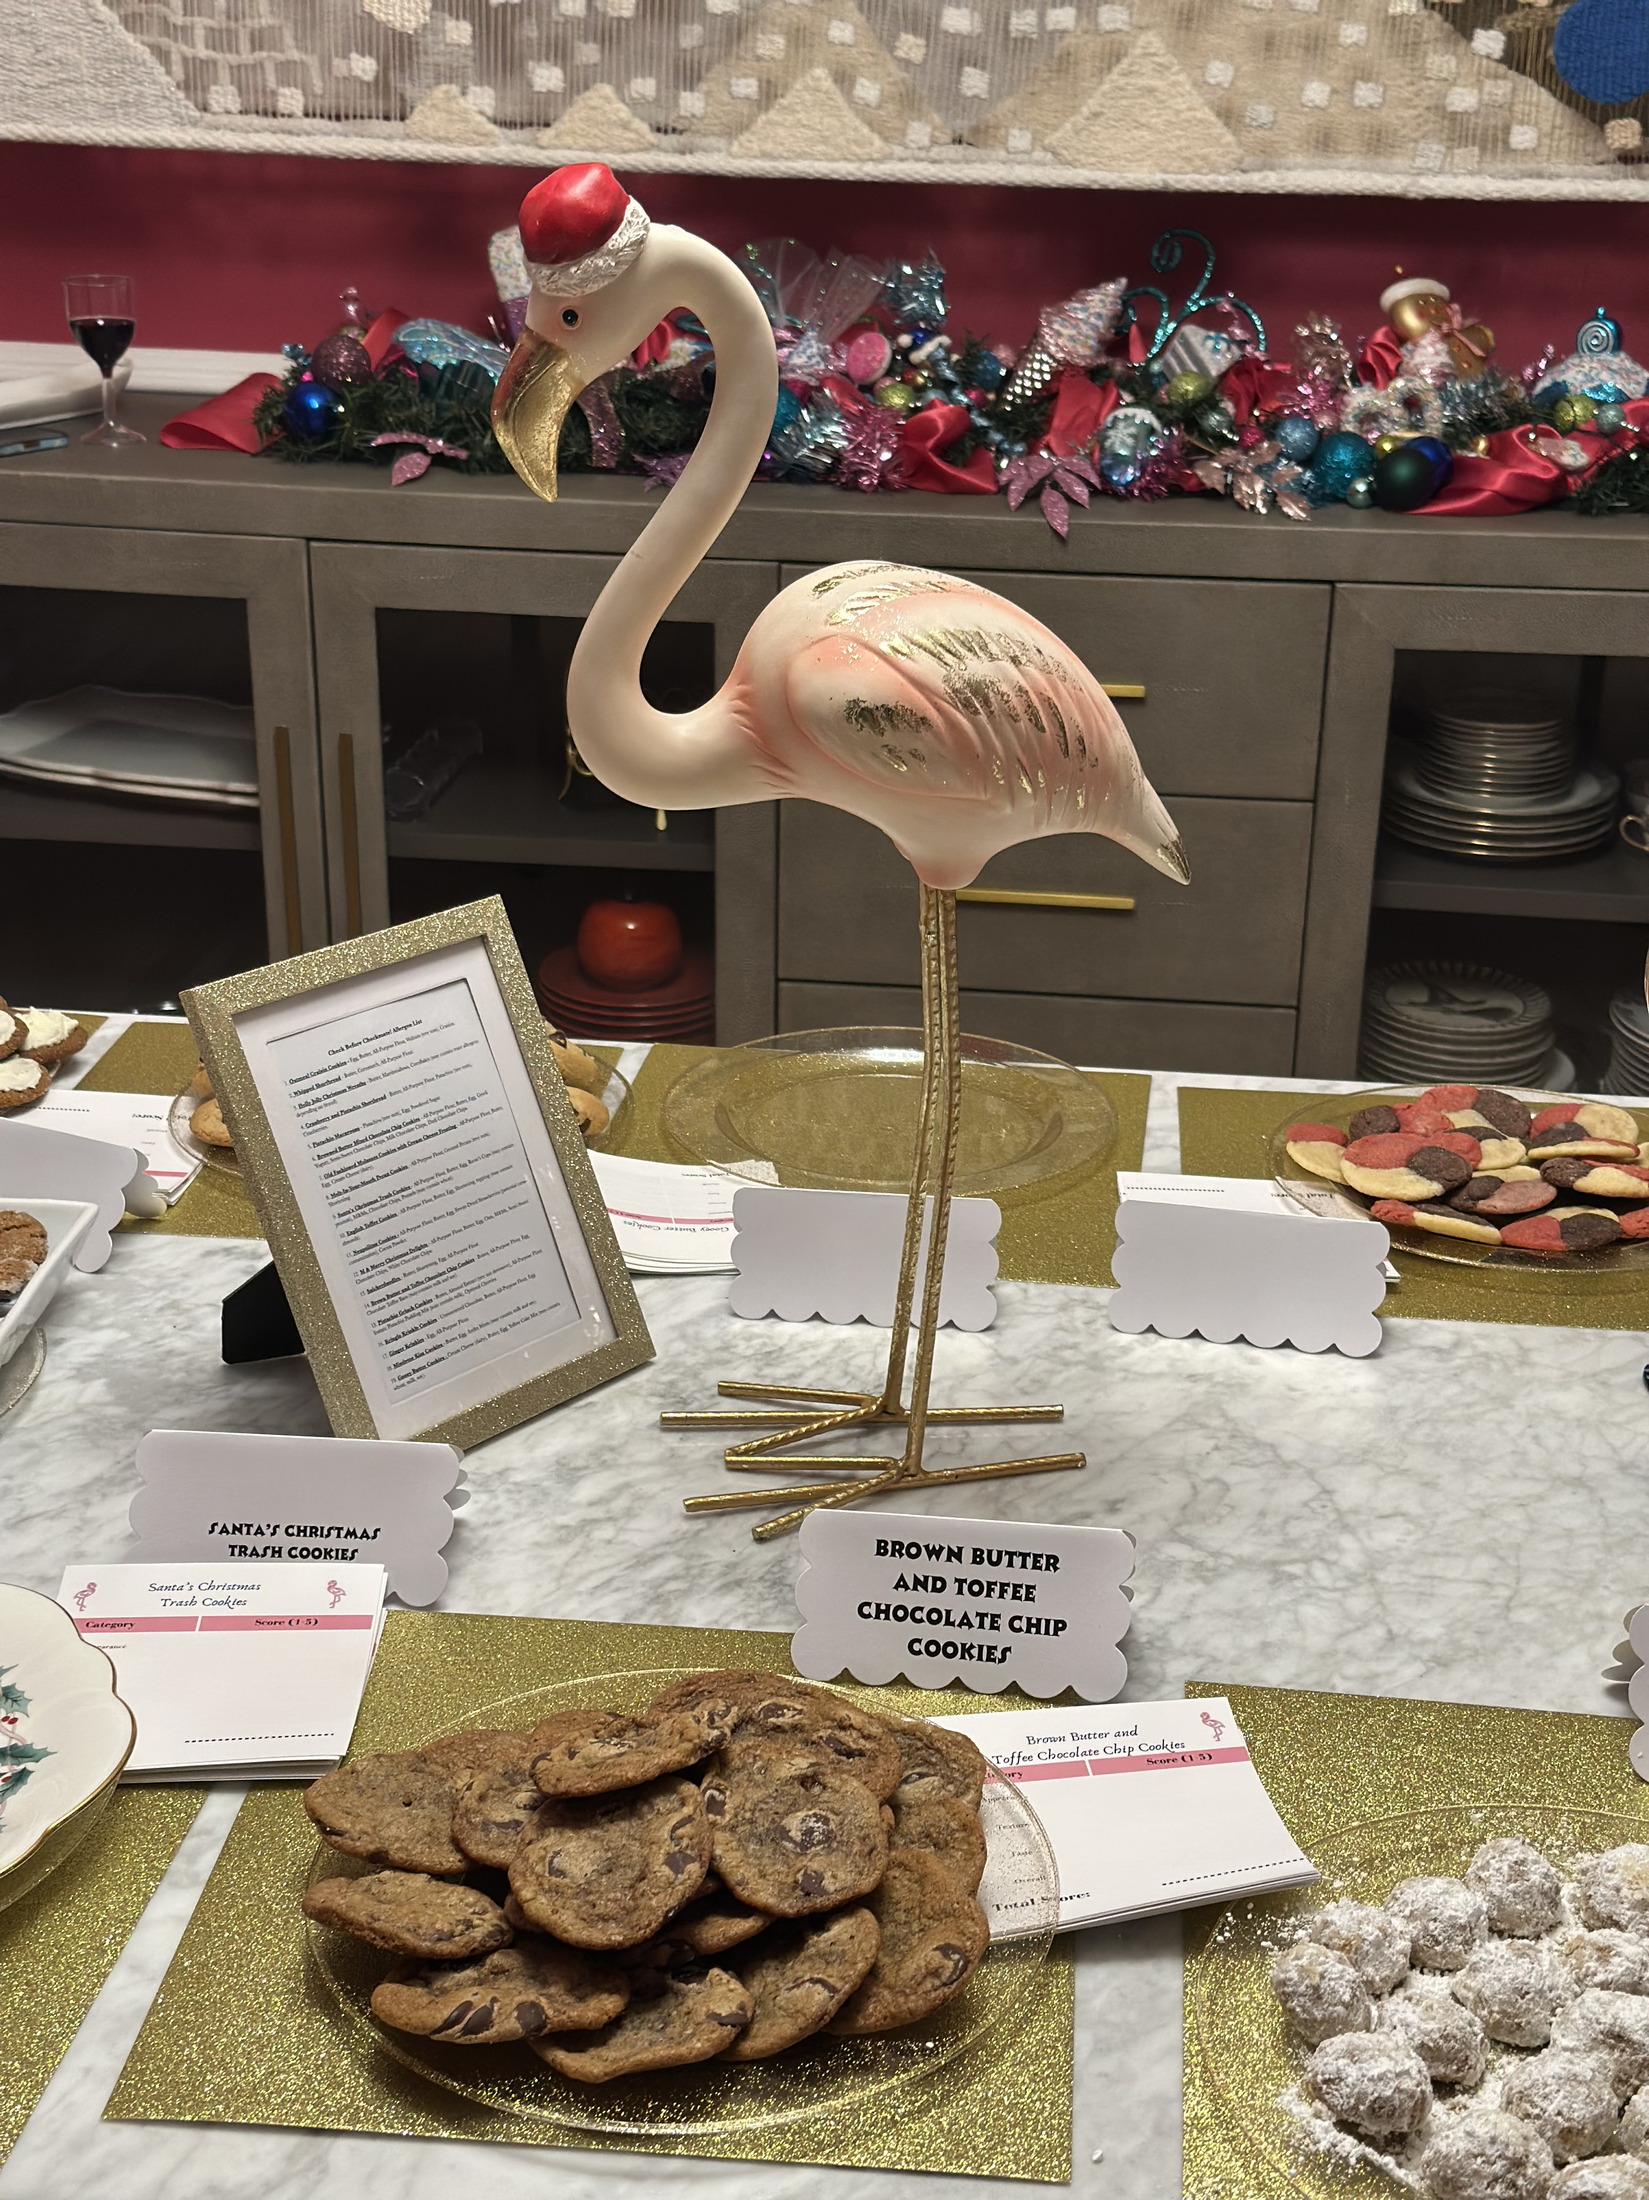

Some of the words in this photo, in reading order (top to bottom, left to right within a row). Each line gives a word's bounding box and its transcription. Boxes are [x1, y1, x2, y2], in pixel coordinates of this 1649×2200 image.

[327, 1047, 344, 1056] Check
[345, 1040, 362, 1050] Before
[622, 1219, 661, 1231] Cookies
[208, 1522, 281, 1538] SANTA'S
[284, 1524, 382, 1541] CHRISTMAS
[228, 1544, 283, 1559] TRASH
[287, 1546, 359, 1562] COOKIES
[874, 1539, 963, 1564] BROWN
[970, 1547, 1060, 1573] BUTTER
[148, 1582, 193, 1592] Santa's
[197, 1581, 262, 1592] Christmas
[892, 1573, 947, 1594] AND
[954, 1577, 1036, 1603] TOFFEE
[161, 1598, 197, 1608] Trash
[201, 1597, 247, 1610] Cookies
[85, 1620, 136, 1630] Category
[254, 1618, 286, 1627] Score
[857, 1601, 1002, 1632] CHOCOLATE
[1008, 1615, 1068, 1637] CHIP
[907, 1638, 1012, 1665] COOKIES
[1026, 1735, 1066, 1746] Brown
[1070, 1730, 1110, 1741] Butter
[1114, 1725, 1139, 1738] and
[992, 1753, 1034, 1766] Toffee
[1037, 1747, 1100, 1761] Chocolate
[1103, 1744, 1134, 1757] Chip
[1138, 1739, 1186, 1753] Cookies
[1146, 1757, 1178, 1766] Score
[992, 1898, 1034, 1912] Total
[1040, 1891, 1091, 1905] Sore:
